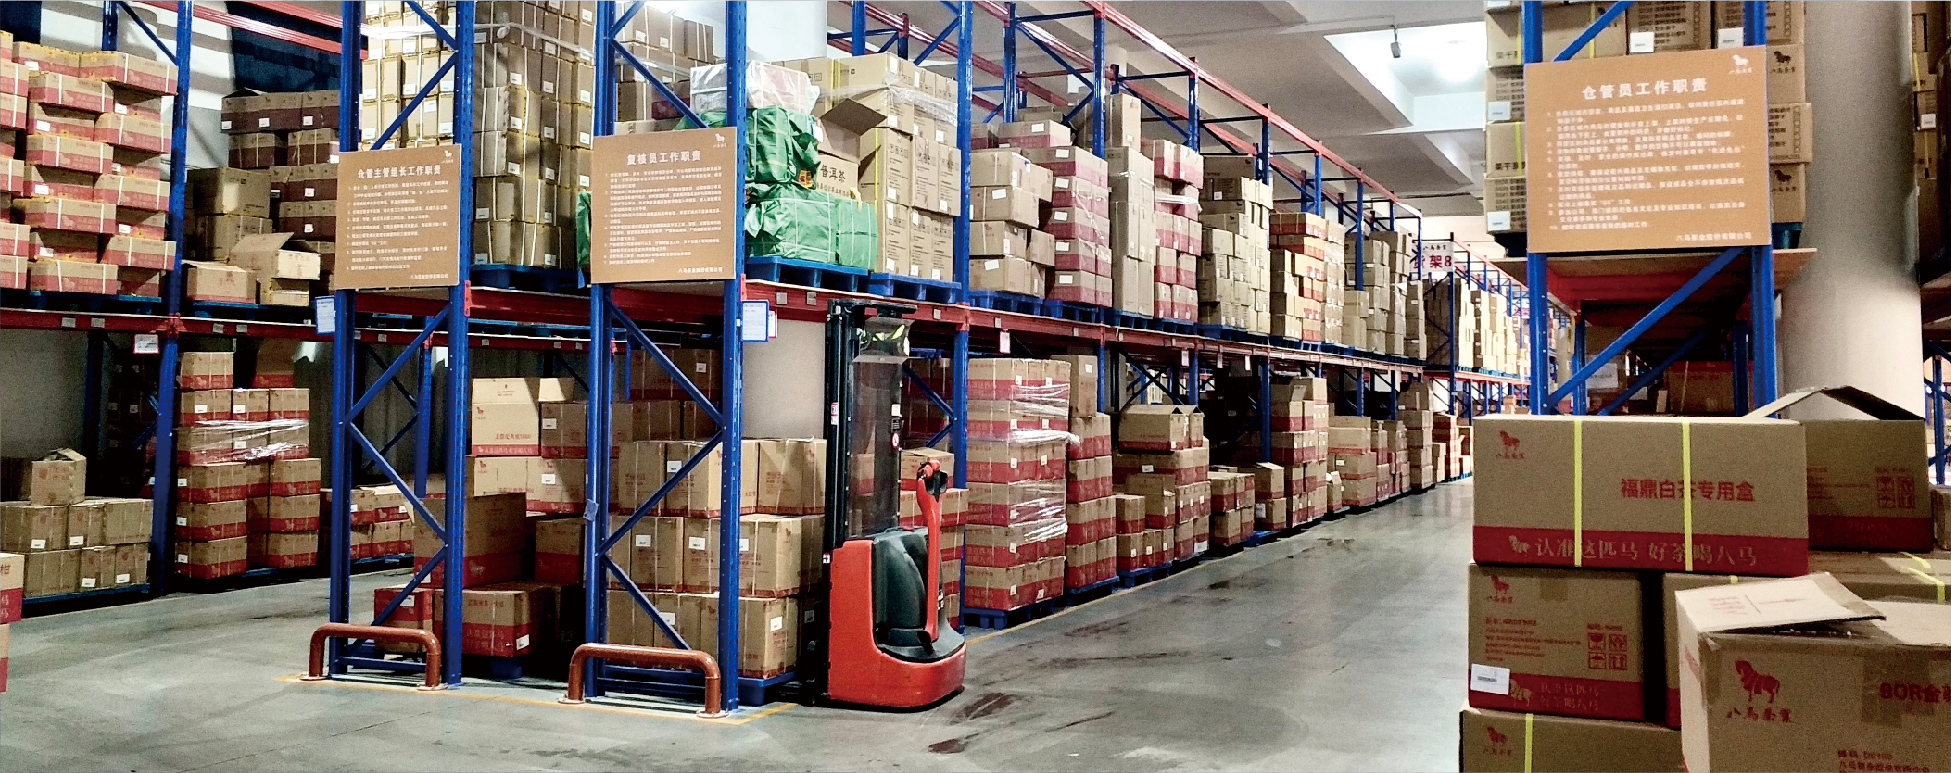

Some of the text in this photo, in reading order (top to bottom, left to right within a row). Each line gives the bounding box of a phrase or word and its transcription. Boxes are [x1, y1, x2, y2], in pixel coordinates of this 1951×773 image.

[1582, 77, 1708, 100] 仓管员工作职责
[626, 150, 701, 166] 复核员工作职责
[820, 164, 846, 183] 普洱茶
[1621, 478, 1755, 502] 福鼎白茶专用盒
[1535, 537, 1757, 567] 认准这匹马 好茶喝八马
